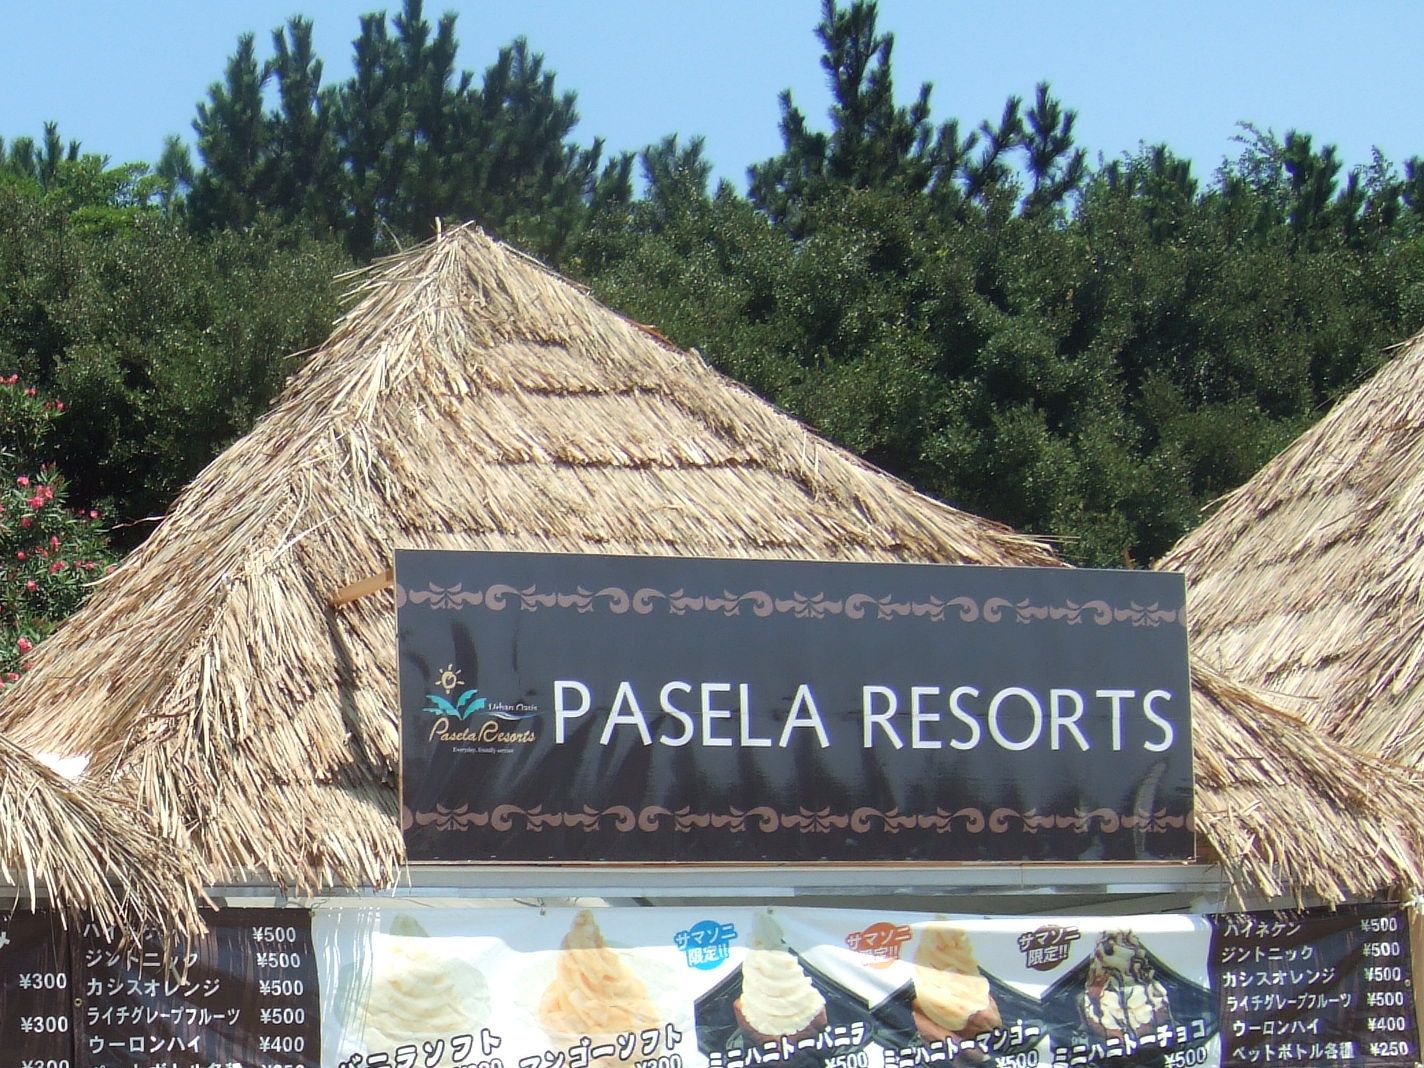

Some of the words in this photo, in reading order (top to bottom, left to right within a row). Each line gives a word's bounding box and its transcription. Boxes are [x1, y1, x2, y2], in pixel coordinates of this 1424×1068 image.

[554, 680, 831, 748] PASELA
[863, 685, 1174, 753] RESORTS
[428, 717, 477, 742] Pasela
[478, 720, 536, 743] Resorts
[252, 926, 297, 943] ¥500
[673, 923, 738, 949] サマソニ
[1360, 916, 1398, 934] ¥500
[846, 924, 912, 950] サマソニ
[1017, 925, 1080, 950] サマソニ
[256, 952, 301, 969] ¥500
[1220, 945, 1314, 964] ジントニック
[1362, 942, 1400, 959] ¥500
[19, 972, 67, 990] ¥300
[86, 977, 220, 998] カシスオレンジ
[259, 979, 304, 997] ¥500
[1222, 967, 1336, 988] カシスオレンジ
[1363, 966, 1401, 983] ¥500
[1226, 992, 1352, 1013] ライチグレープフルーツ
[1366, 991, 1404, 1008] ¥500
[20, 1015, 69, 1033] ¥300
[87, 1006, 241, 1026] ライチグレープフルーツ
[260, 1008, 305, 1025] ¥500
[1231, 1018, 1320, 1037] ウーロンハイ
[1367, 1015, 1406, 1033] ¥400
[89, 1034, 201, 1054] ウーロンハイ
[259, 1036, 305, 1053] ¥400
[1231, 1042, 1355, 1063] ペットボトル各種
[1370, 1041, 1409, 1058] ¥250
